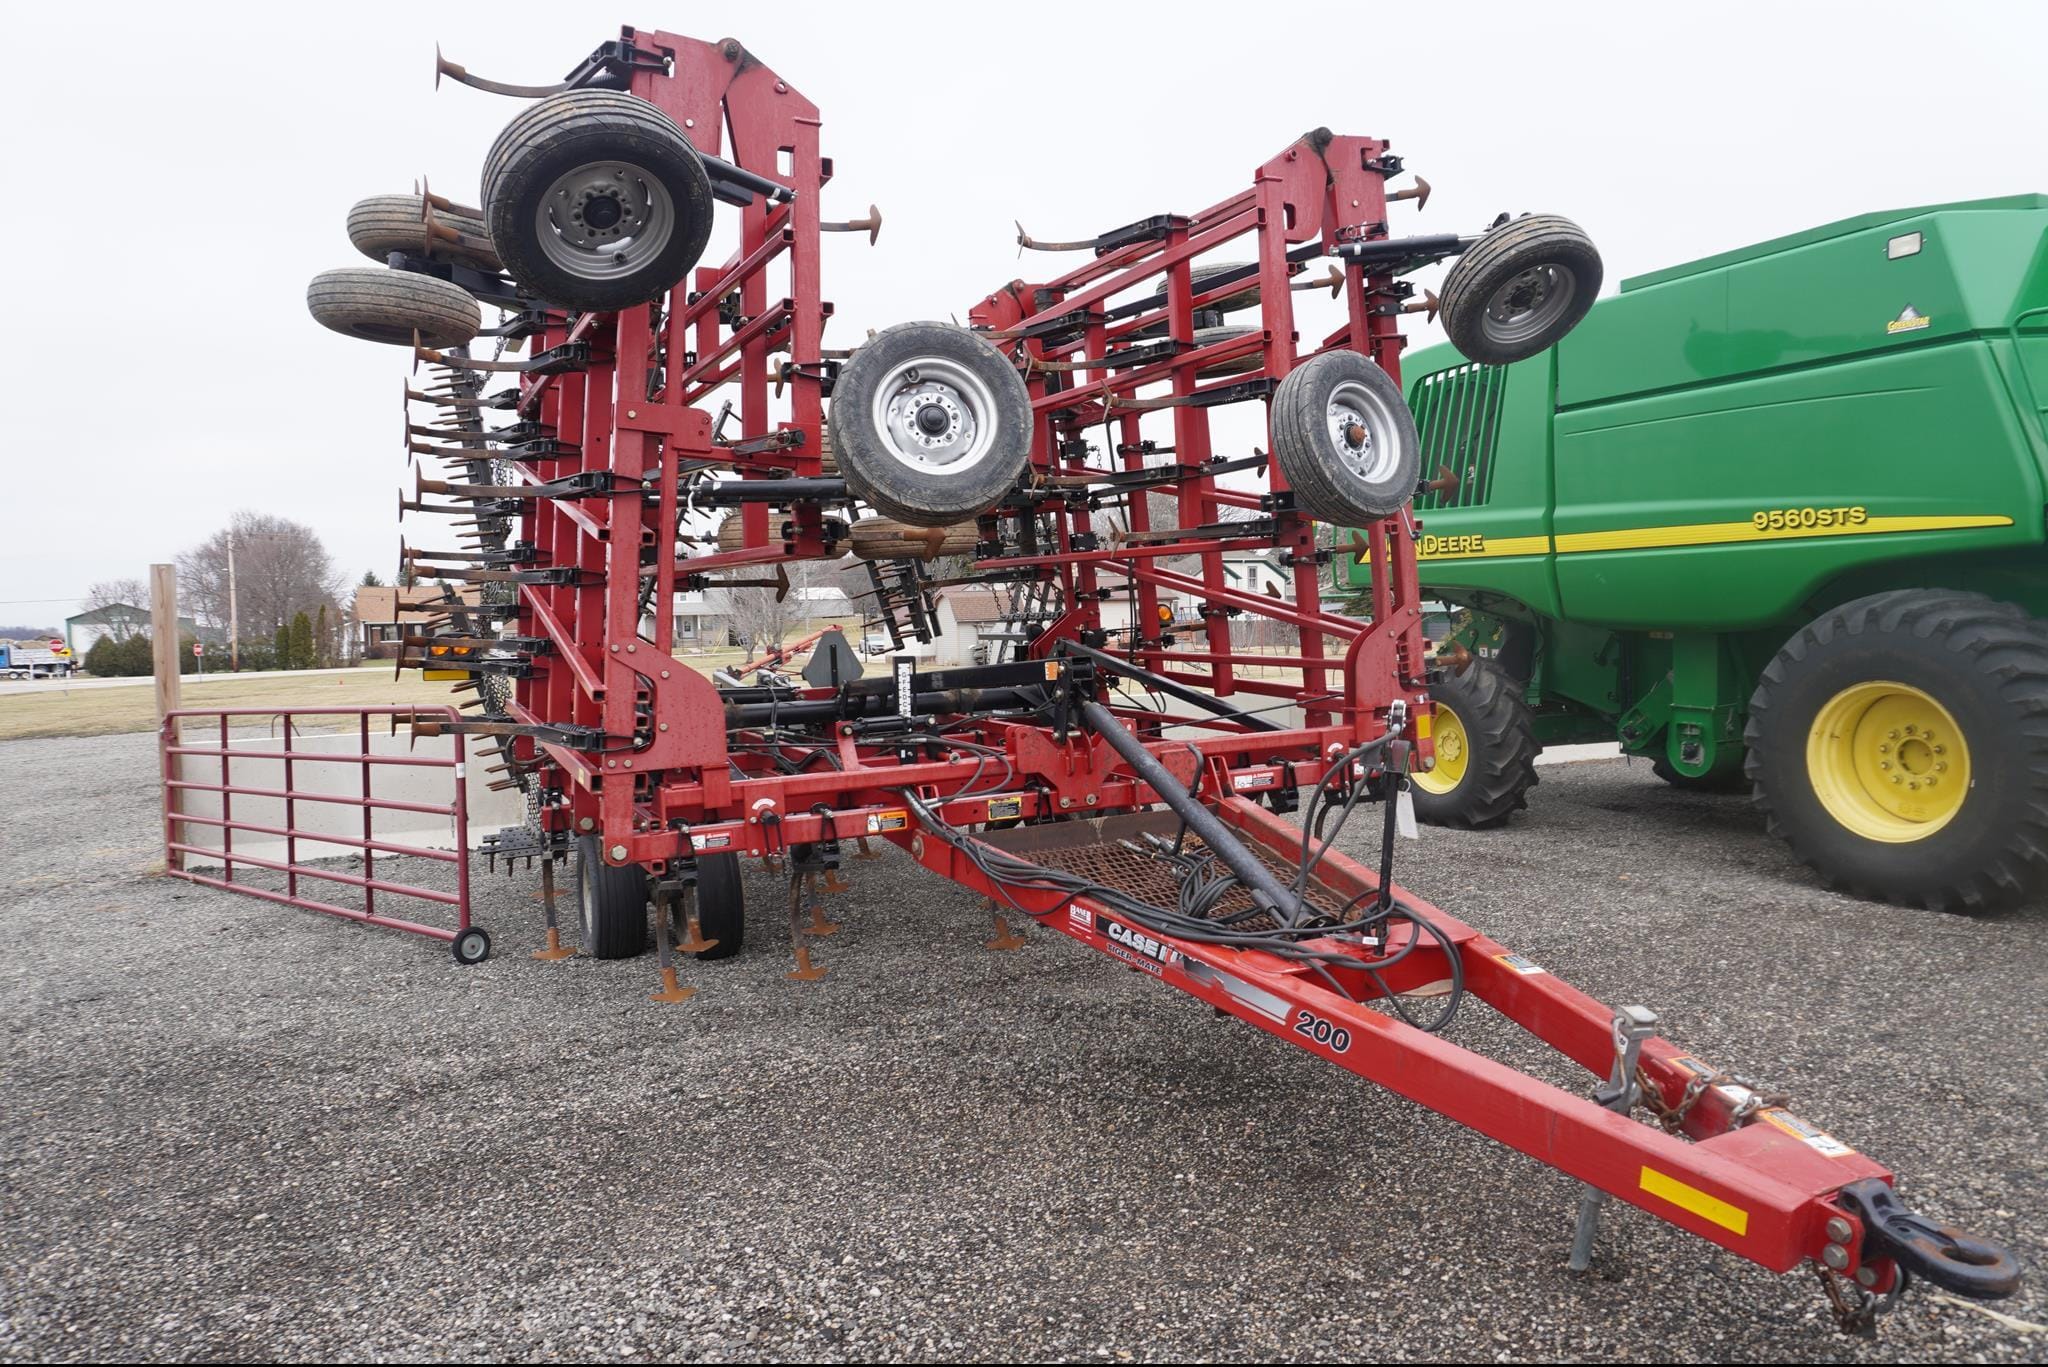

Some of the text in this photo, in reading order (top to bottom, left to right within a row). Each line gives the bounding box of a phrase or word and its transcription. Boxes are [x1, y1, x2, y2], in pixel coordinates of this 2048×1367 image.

[1752, 506, 1867, 530] 9560STS
[1424, 536, 1483, 554] DEERE
[1108, 922, 1160, 958] CASE
[1293, 1009, 1352, 1054] 200
